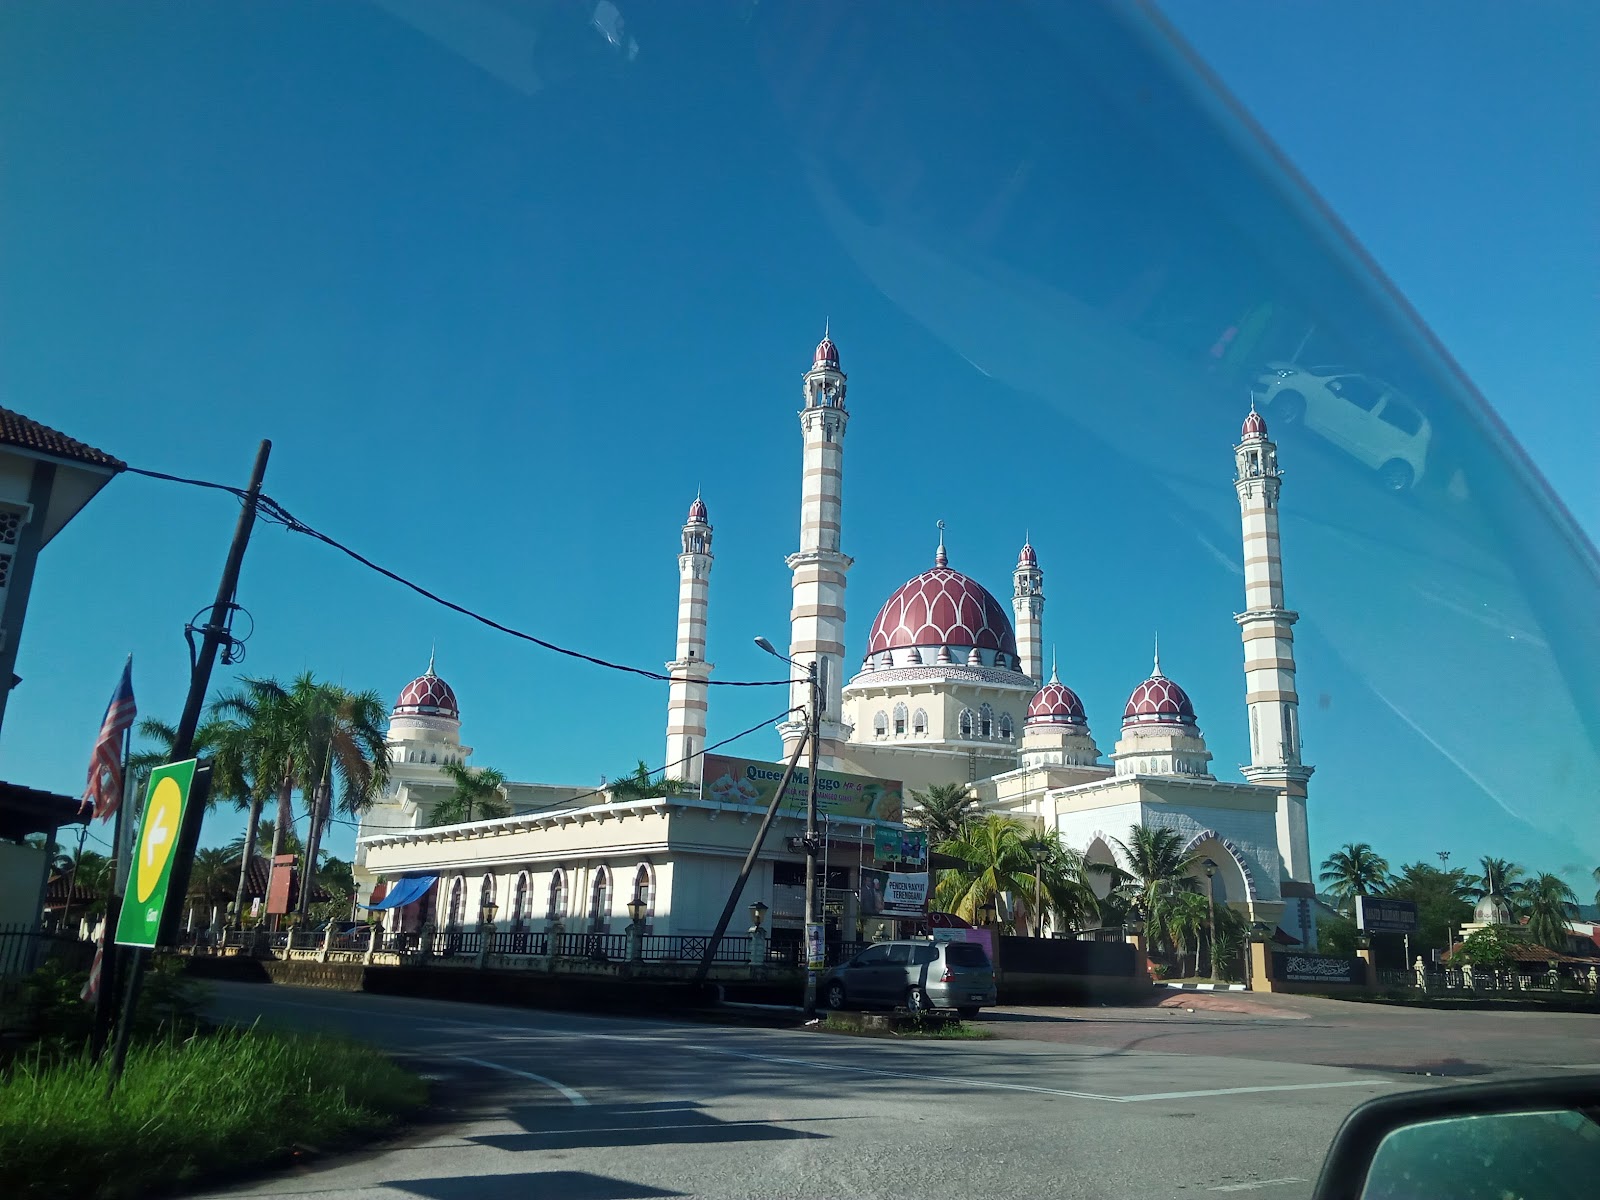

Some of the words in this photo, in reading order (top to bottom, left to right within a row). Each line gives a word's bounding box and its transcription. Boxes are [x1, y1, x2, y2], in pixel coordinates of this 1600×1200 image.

[791, 771, 841, 790] Maggo
[908, 882, 925, 892] RAKYAT
[893, 890, 923, 901] TERENGGANU
